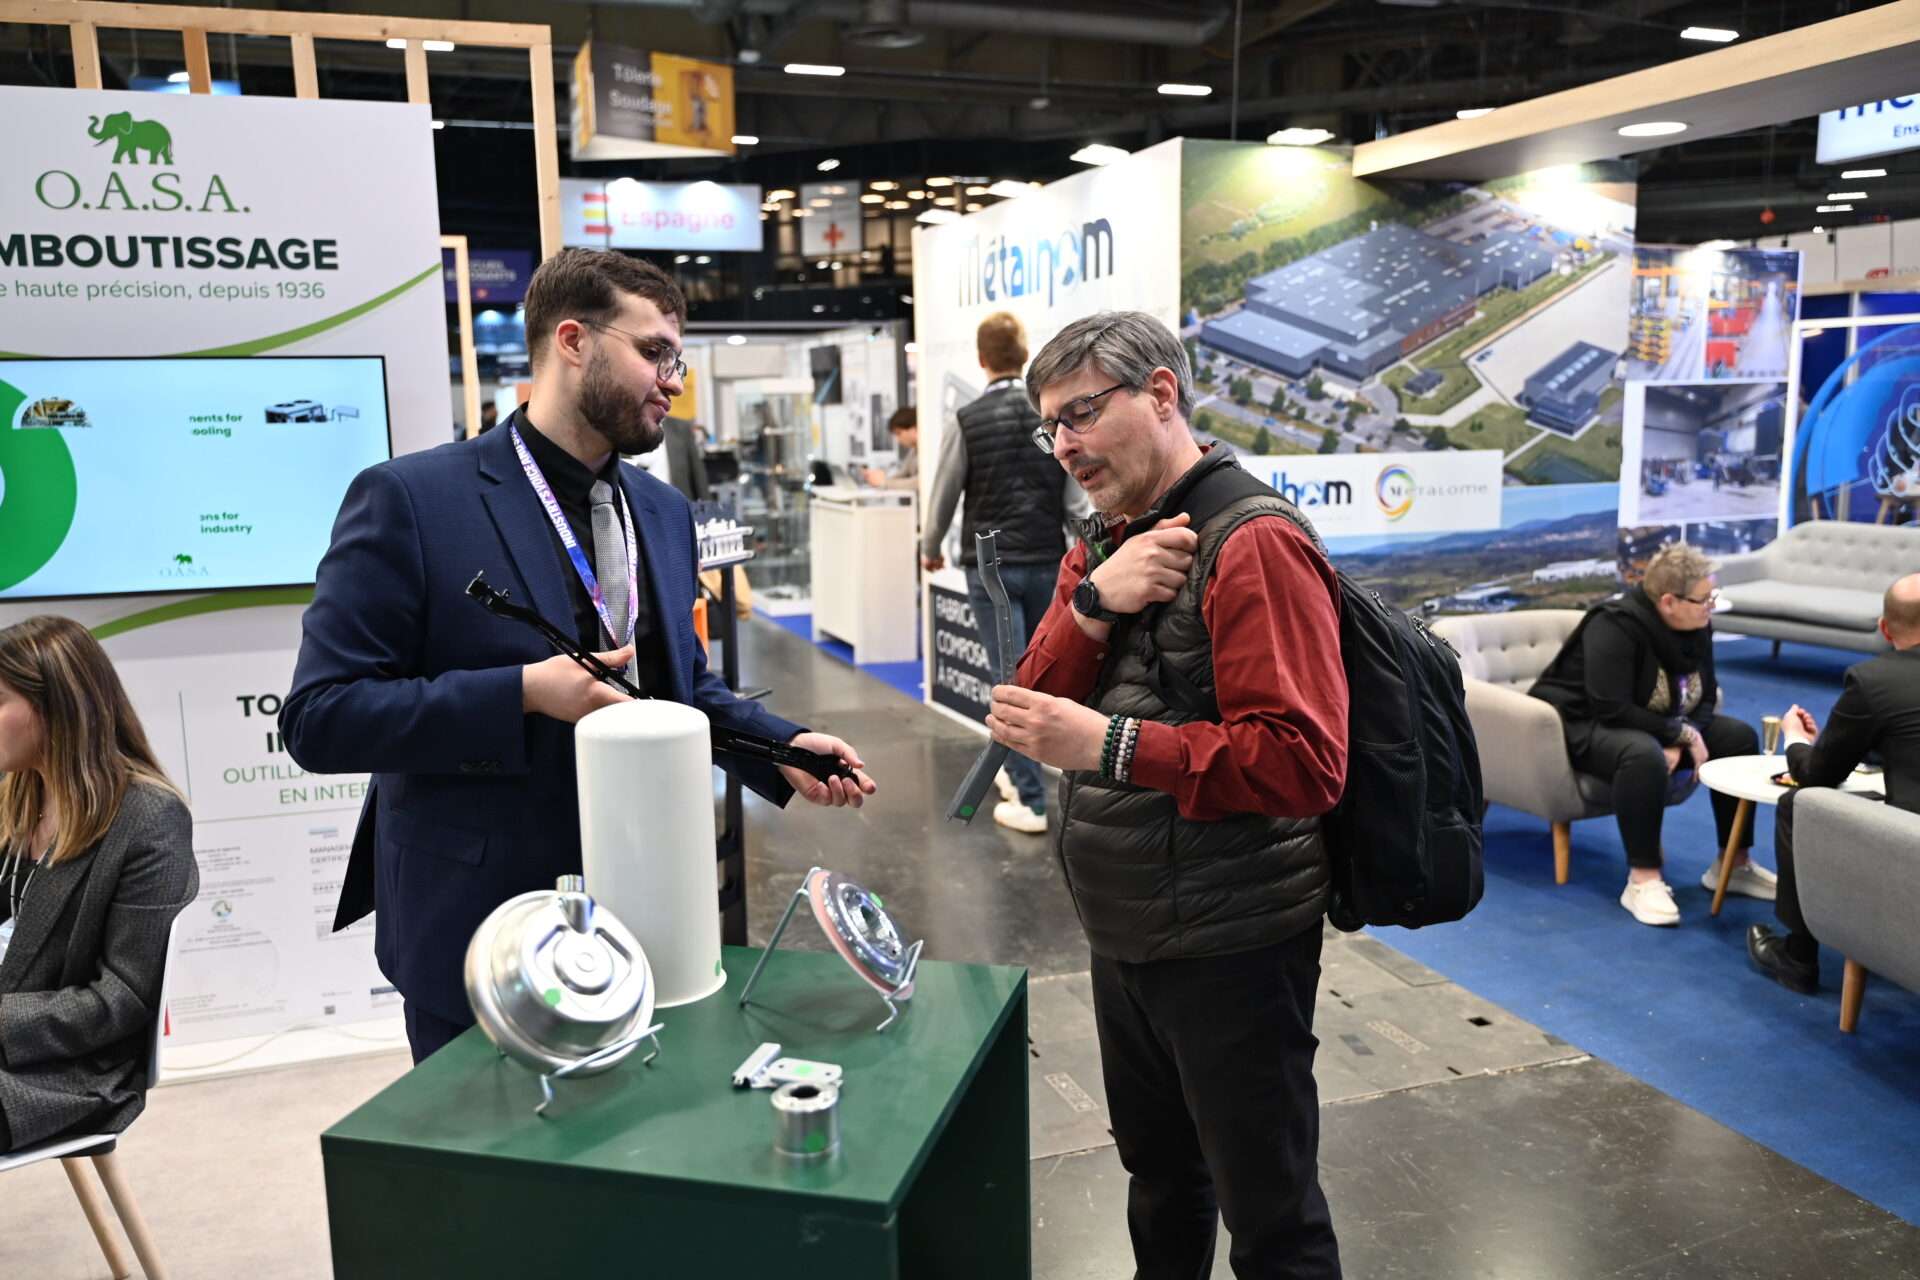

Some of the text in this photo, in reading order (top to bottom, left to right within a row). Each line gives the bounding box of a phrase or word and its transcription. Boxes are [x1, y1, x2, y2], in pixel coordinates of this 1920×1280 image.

[35, 169, 251, 213] O.A.S.A.
[15, 279, 79, 298] haute
[87, 279, 193, 302] précision,
[199, 281, 270, 302] depuis
[276, 281, 326, 299] 1936
[225, 413, 243, 423] for
[221, 511, 239, 521] for
[200, 524, 253, 535] industry
[223, 763, 314, 785] OUTILL
[279, 787, 308, 804] EN
